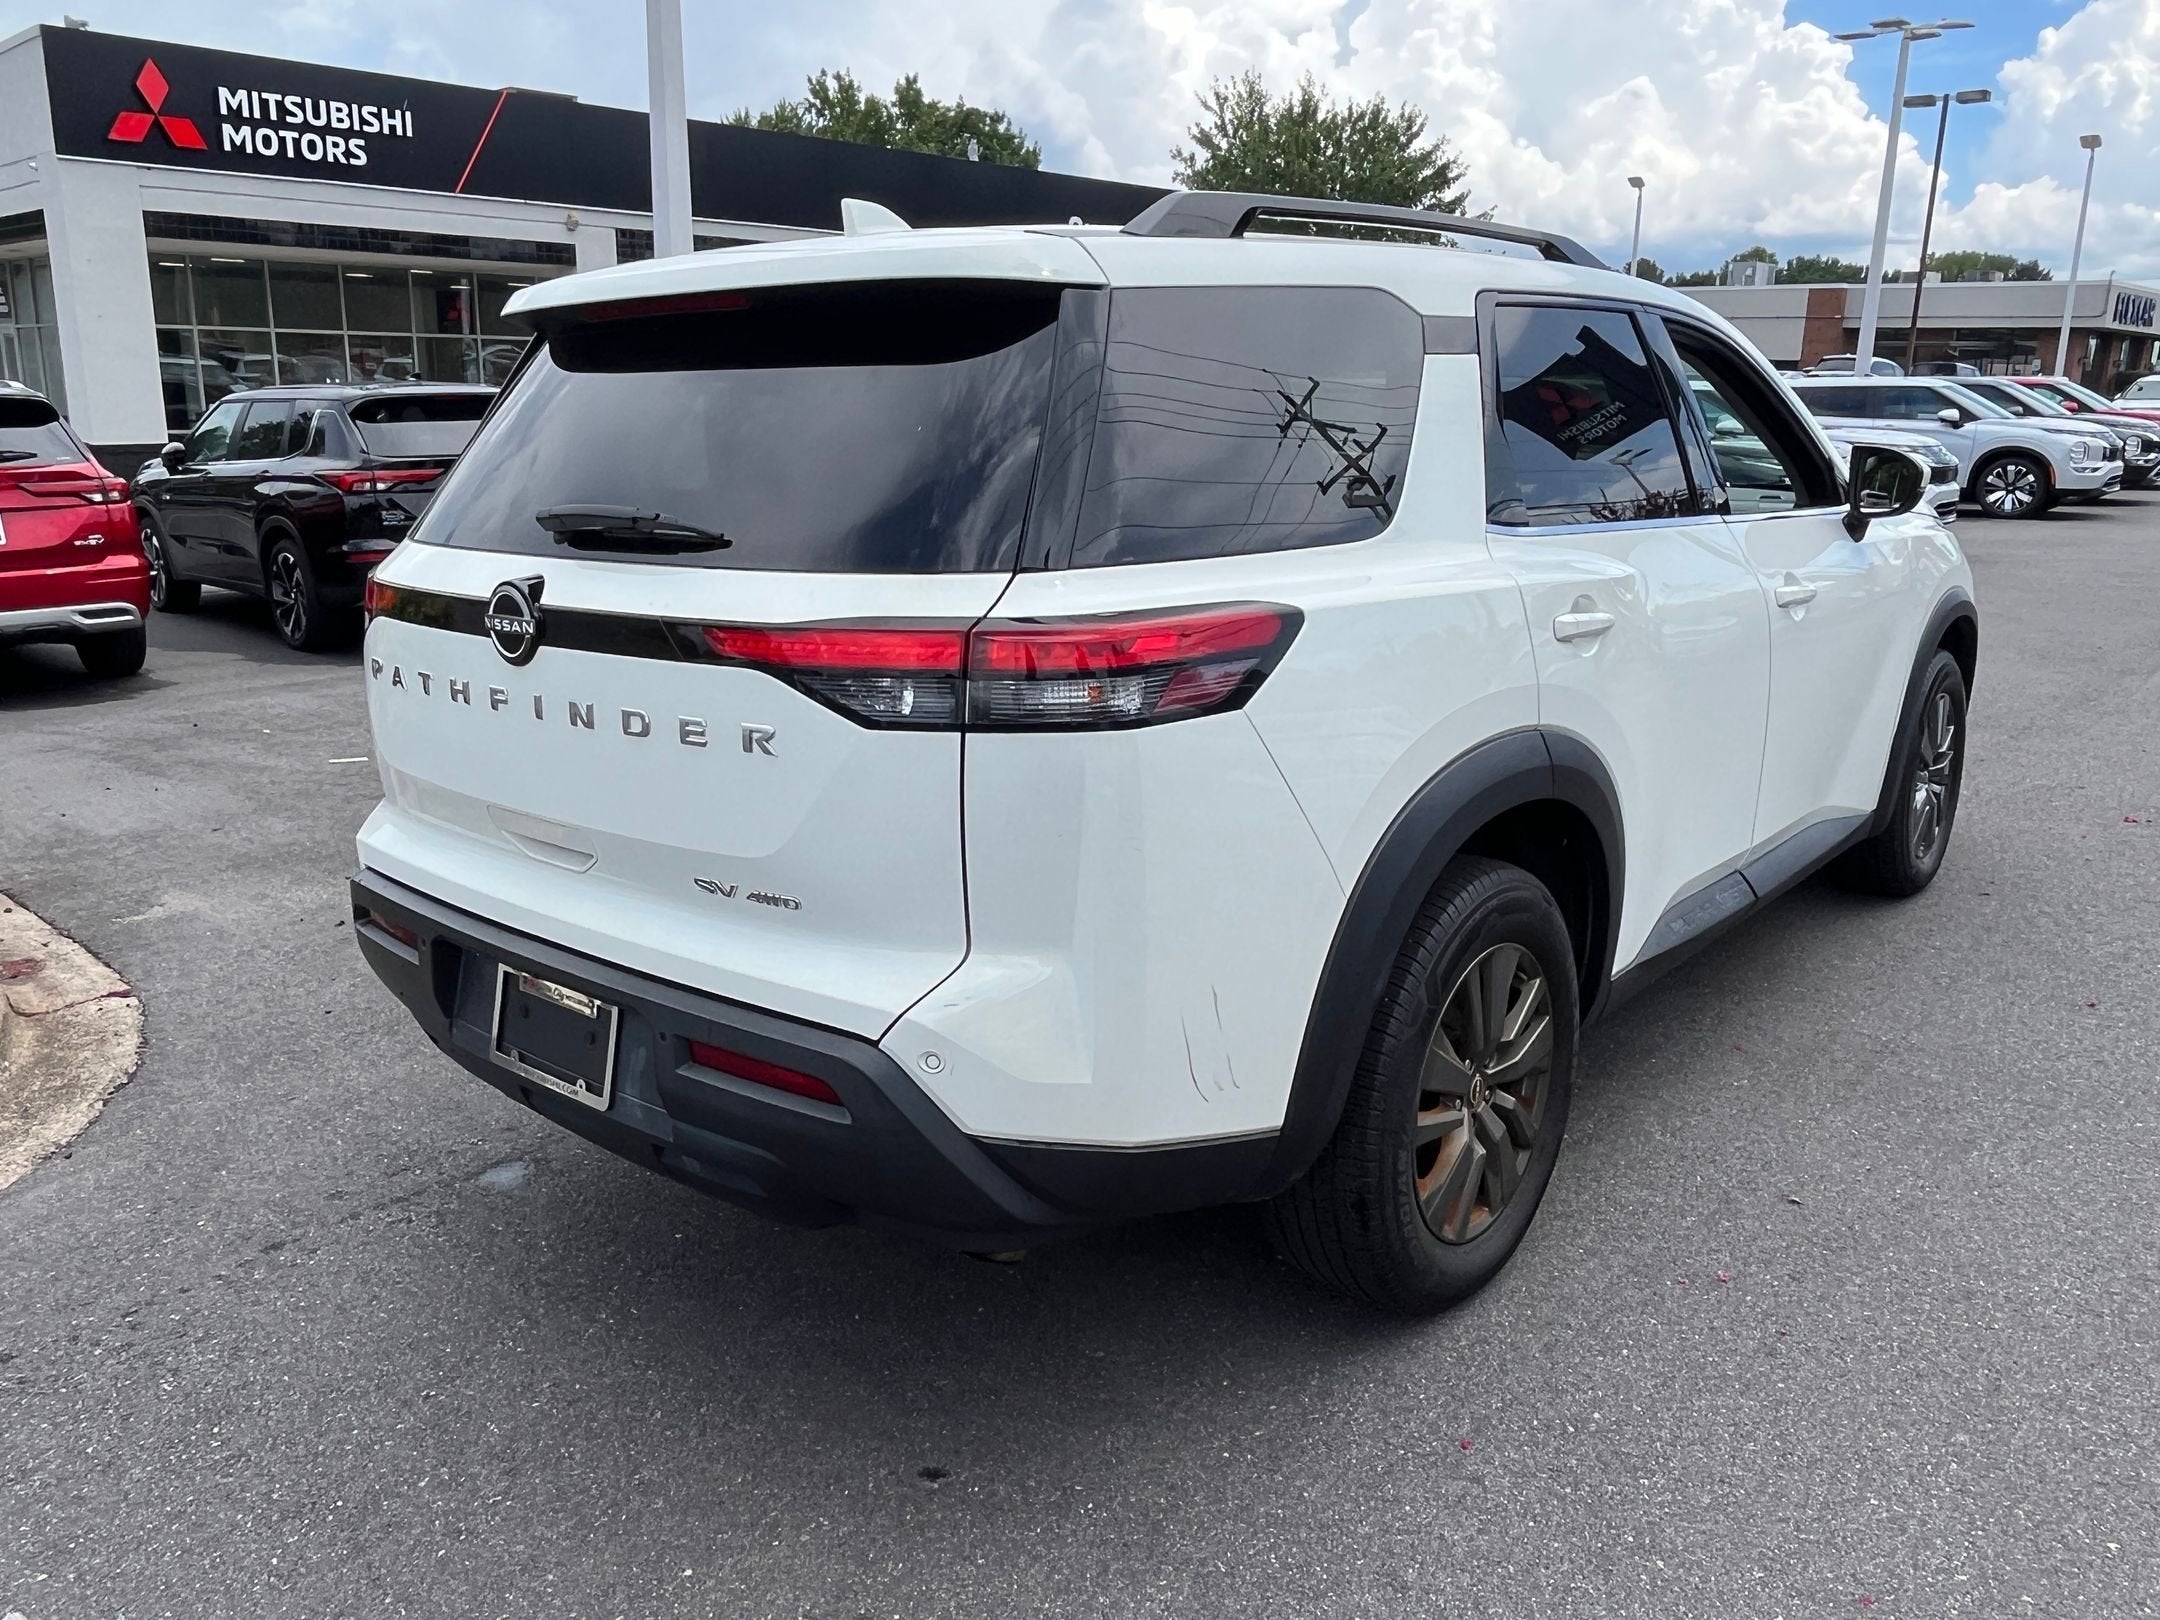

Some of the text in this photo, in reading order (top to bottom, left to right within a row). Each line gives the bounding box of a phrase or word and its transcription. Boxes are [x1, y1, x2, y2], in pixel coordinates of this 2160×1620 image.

[218, 86, 413, 137] MITSUBISHI
[221, 123, 368, 166] MOTORS
[484, 616, 534, 634] NISSAN
[371, 656, 779, 758] PATHFINDER
[693, 876, 802, 911] SV 4WD
